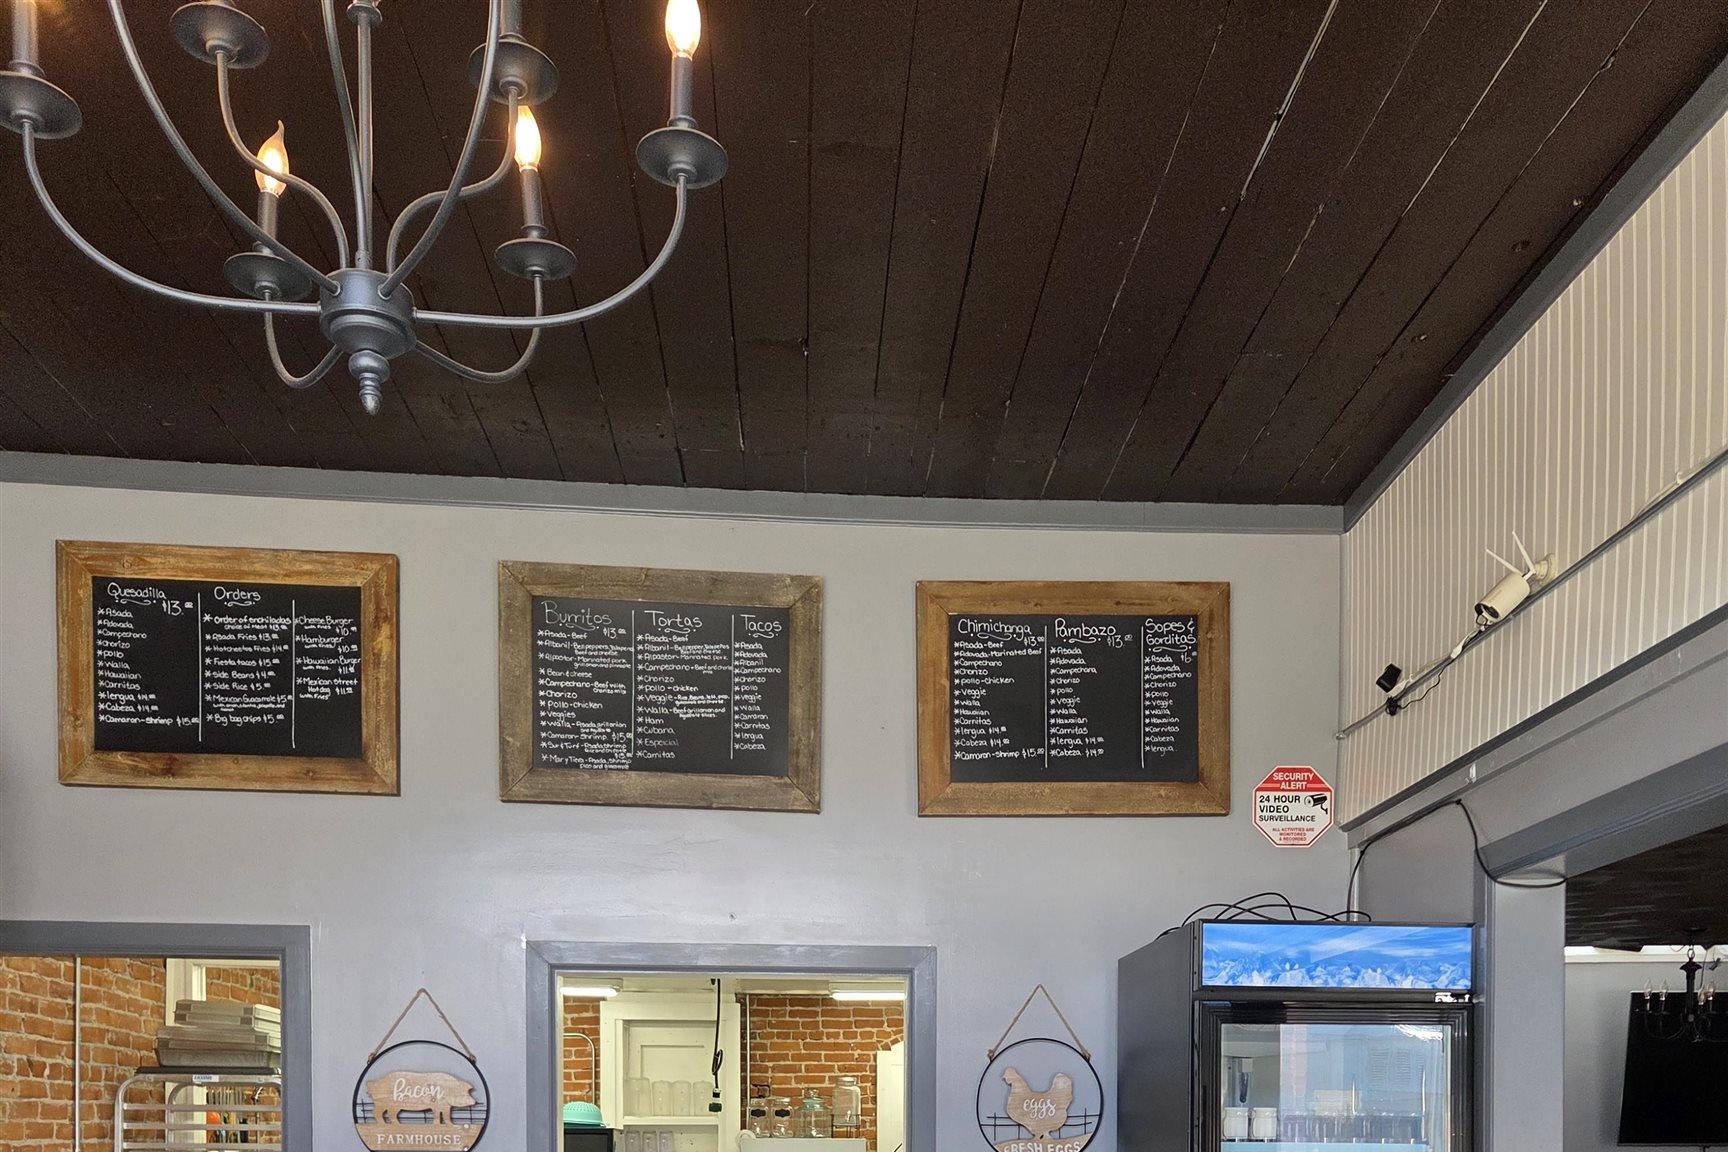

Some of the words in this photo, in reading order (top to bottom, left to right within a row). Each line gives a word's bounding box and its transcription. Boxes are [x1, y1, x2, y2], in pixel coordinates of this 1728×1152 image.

[107, 582, 167, 599] Quesadilla
[214, 586, 261, 601] Orders
[106, 608, 134, 618] Asada
[541, 600, 613, 625] Burritos
[238, 615, 247, 623] of
[299, 615, 325, 624] Cheese
[326, 616, 354, 628] Burger
[644, 610, 703, 628] Tortas
[740, 614, 782, 631] Tacos
[958, 618, 1032, 641] Chimichanga
[1055, 618, 1116, 638] Pambazo
[1145, 618, 1185, 634] Sopes
[301, 634, 344, 648] Hamburger
[1146, 633, 1196, 645] Gorditas
[740, 642, 763, 650] Asada
[1057, 646, 1082, 655] Asada
[214, 658, 236, 666] Fiesta
[303, 656, 339, 665] Hawaiian
[339, 655, 361, 667] Burger
[1056, 657, 1086, 665] Adovada
[105, 670, 142, 679] Hawaiian
[231, 671, 255, 679] Beans
[547, 668, 564, 677] Bean
[105, 681, 141, 690] Carnitas
[303, 677, 333, 685] Mexican
[232, 682, 248, 690] Rice
[546, 689, 578, 699] Chorizo
[644, 693, 673, 704] Veggie
[105, 702, 136, 711] Cabeza
[214, 714, 228, 726] Big
[229, 714, 243, 726] bag
[546, 711, 576, 721] Veggies
[1056, 716, 1088, 724] Hawaiian
[960, 716, 992, 726] Carnitas
[643, 726, 675, 735] Cubana
[1055, 726, 1089, 735] Carnitas
[740, 742, 766, 750] Cabeza
[961, 738, 988, 747] Cabeza
[1272, 772, 1314, 781] SECURITY
[1280, 782, 1307, 790] ALERT
[1259, 795, 1270, 803] 24
[1274, 795, 1301, 803] HOUR
[1259, 805, 1289, 813] VIDEO
[1023, 1099, 1056, 1119] eggs
[376, 1134, 461, 1145] FARMHOUSE
